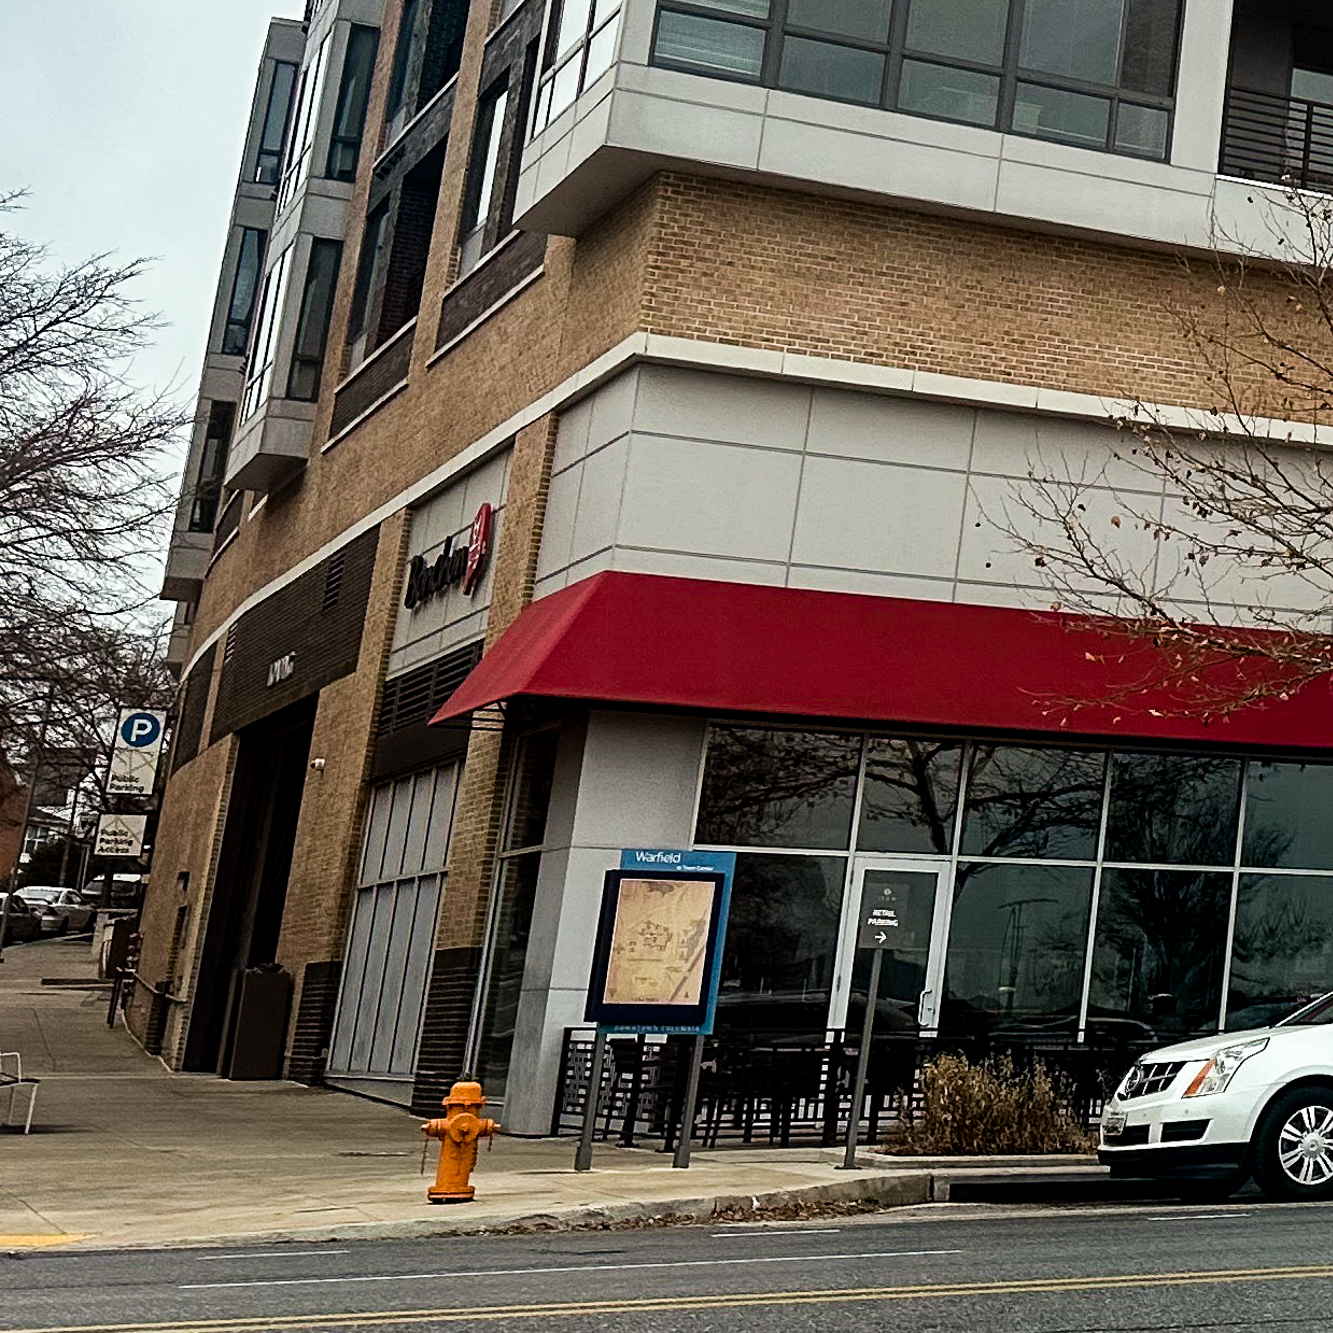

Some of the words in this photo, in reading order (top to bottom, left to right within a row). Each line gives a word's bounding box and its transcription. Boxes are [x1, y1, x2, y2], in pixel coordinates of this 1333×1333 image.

[130, 719, 152, 741] P
[109, 782, 145, 793] Parking
[101, 828, 129, 837] Public
[99, 836, 134, 847] Parking
[635, 851, 681, 864] Warfield
[867, 918, 899, 927] PARKING
